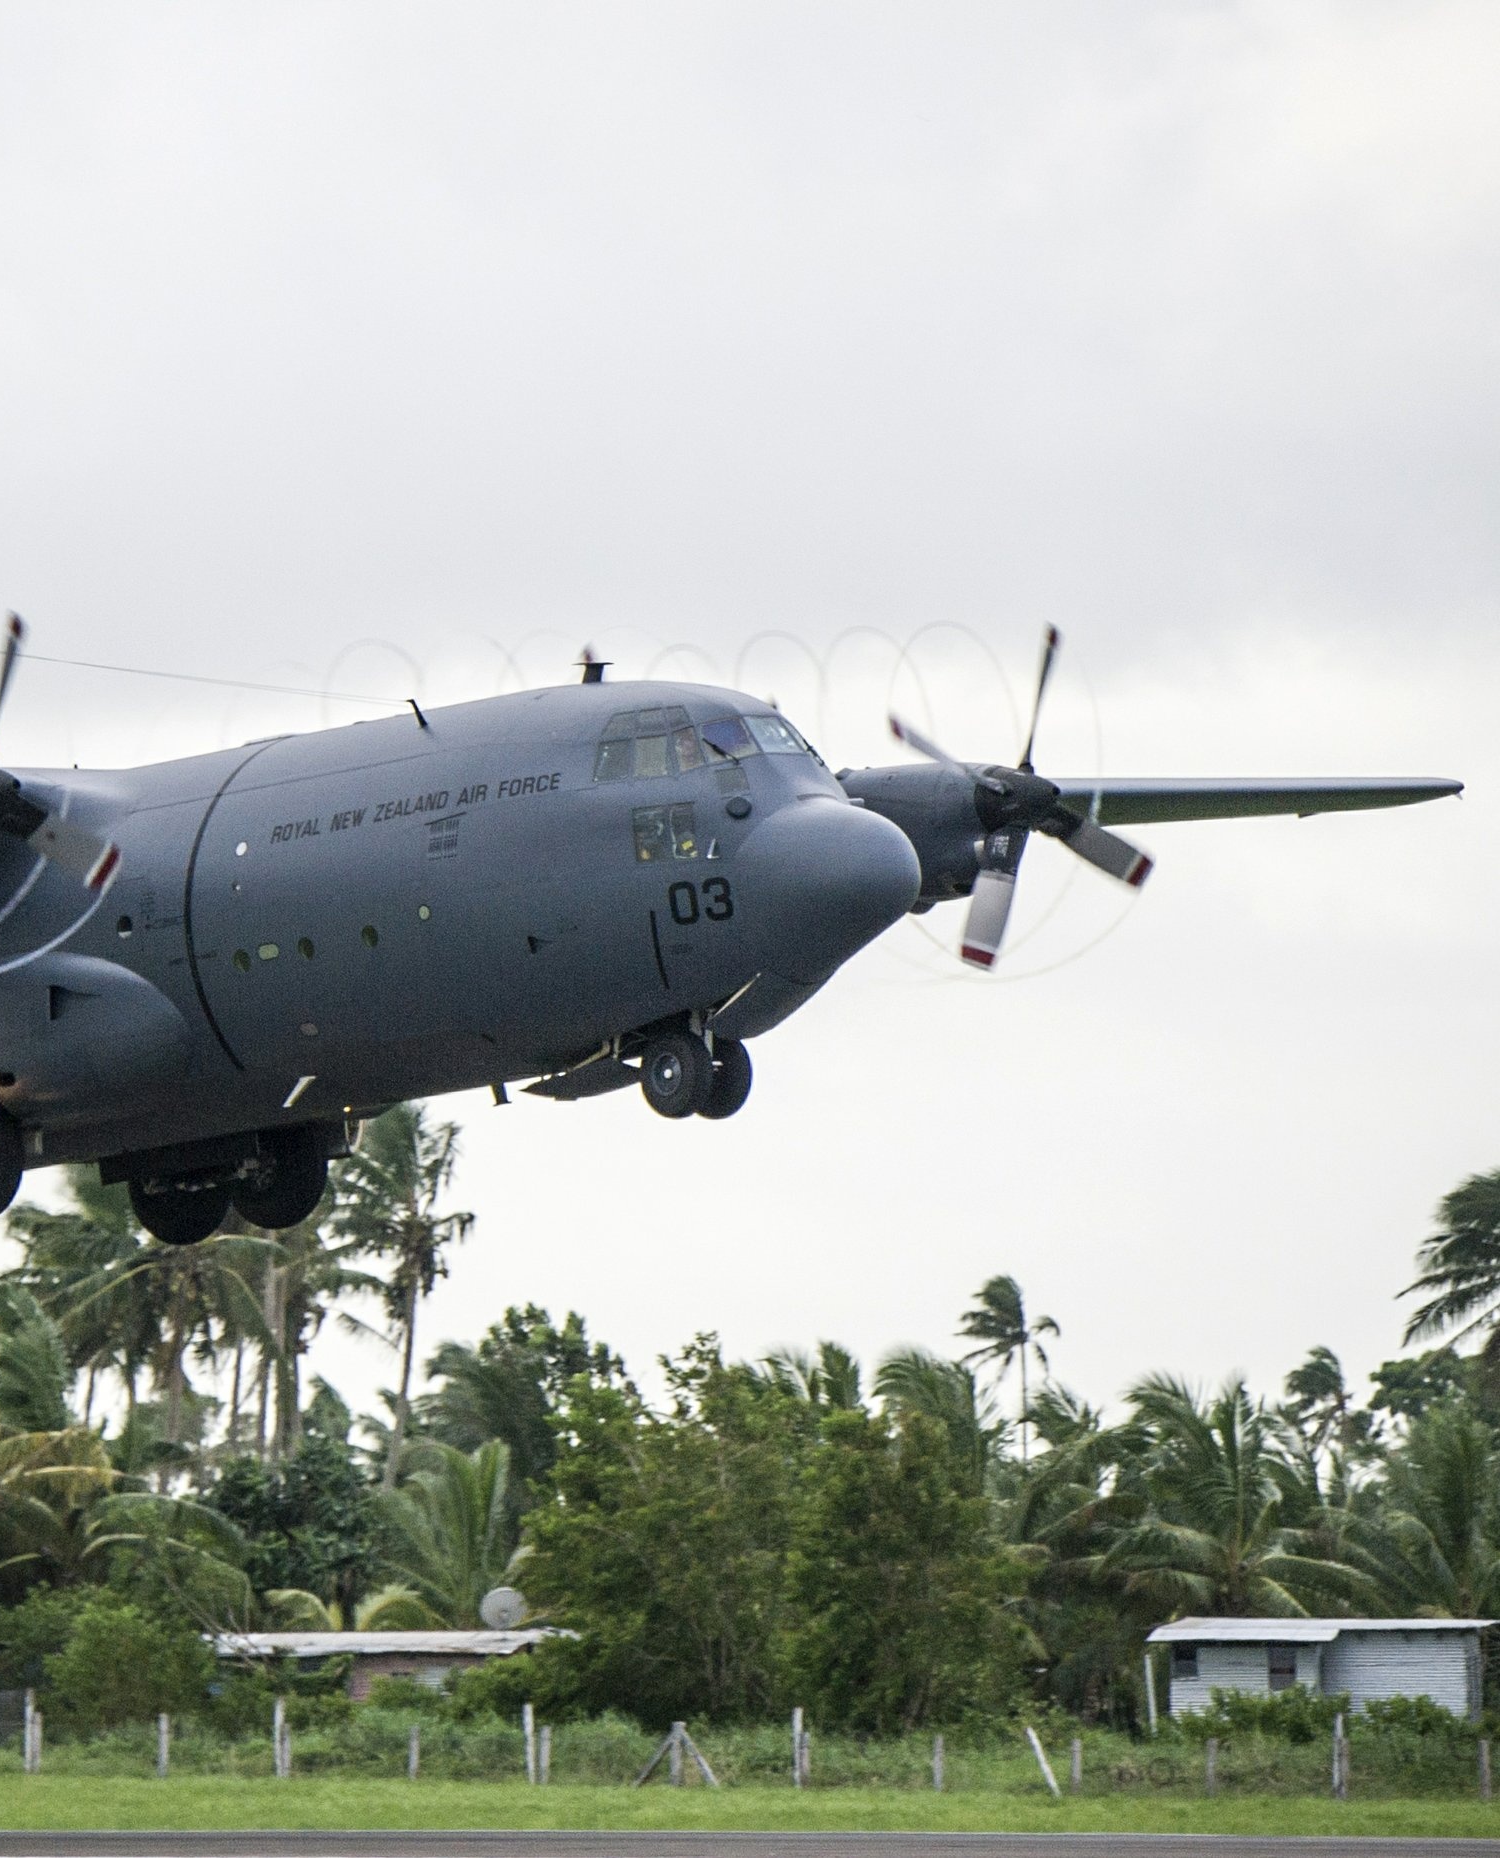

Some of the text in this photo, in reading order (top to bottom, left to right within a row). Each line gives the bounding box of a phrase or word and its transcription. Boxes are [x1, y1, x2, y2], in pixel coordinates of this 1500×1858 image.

[269, 772, 562, 845] ROYAL NEW ZEALAND AIR FORCE
[668, 874, 735, 925] 03
